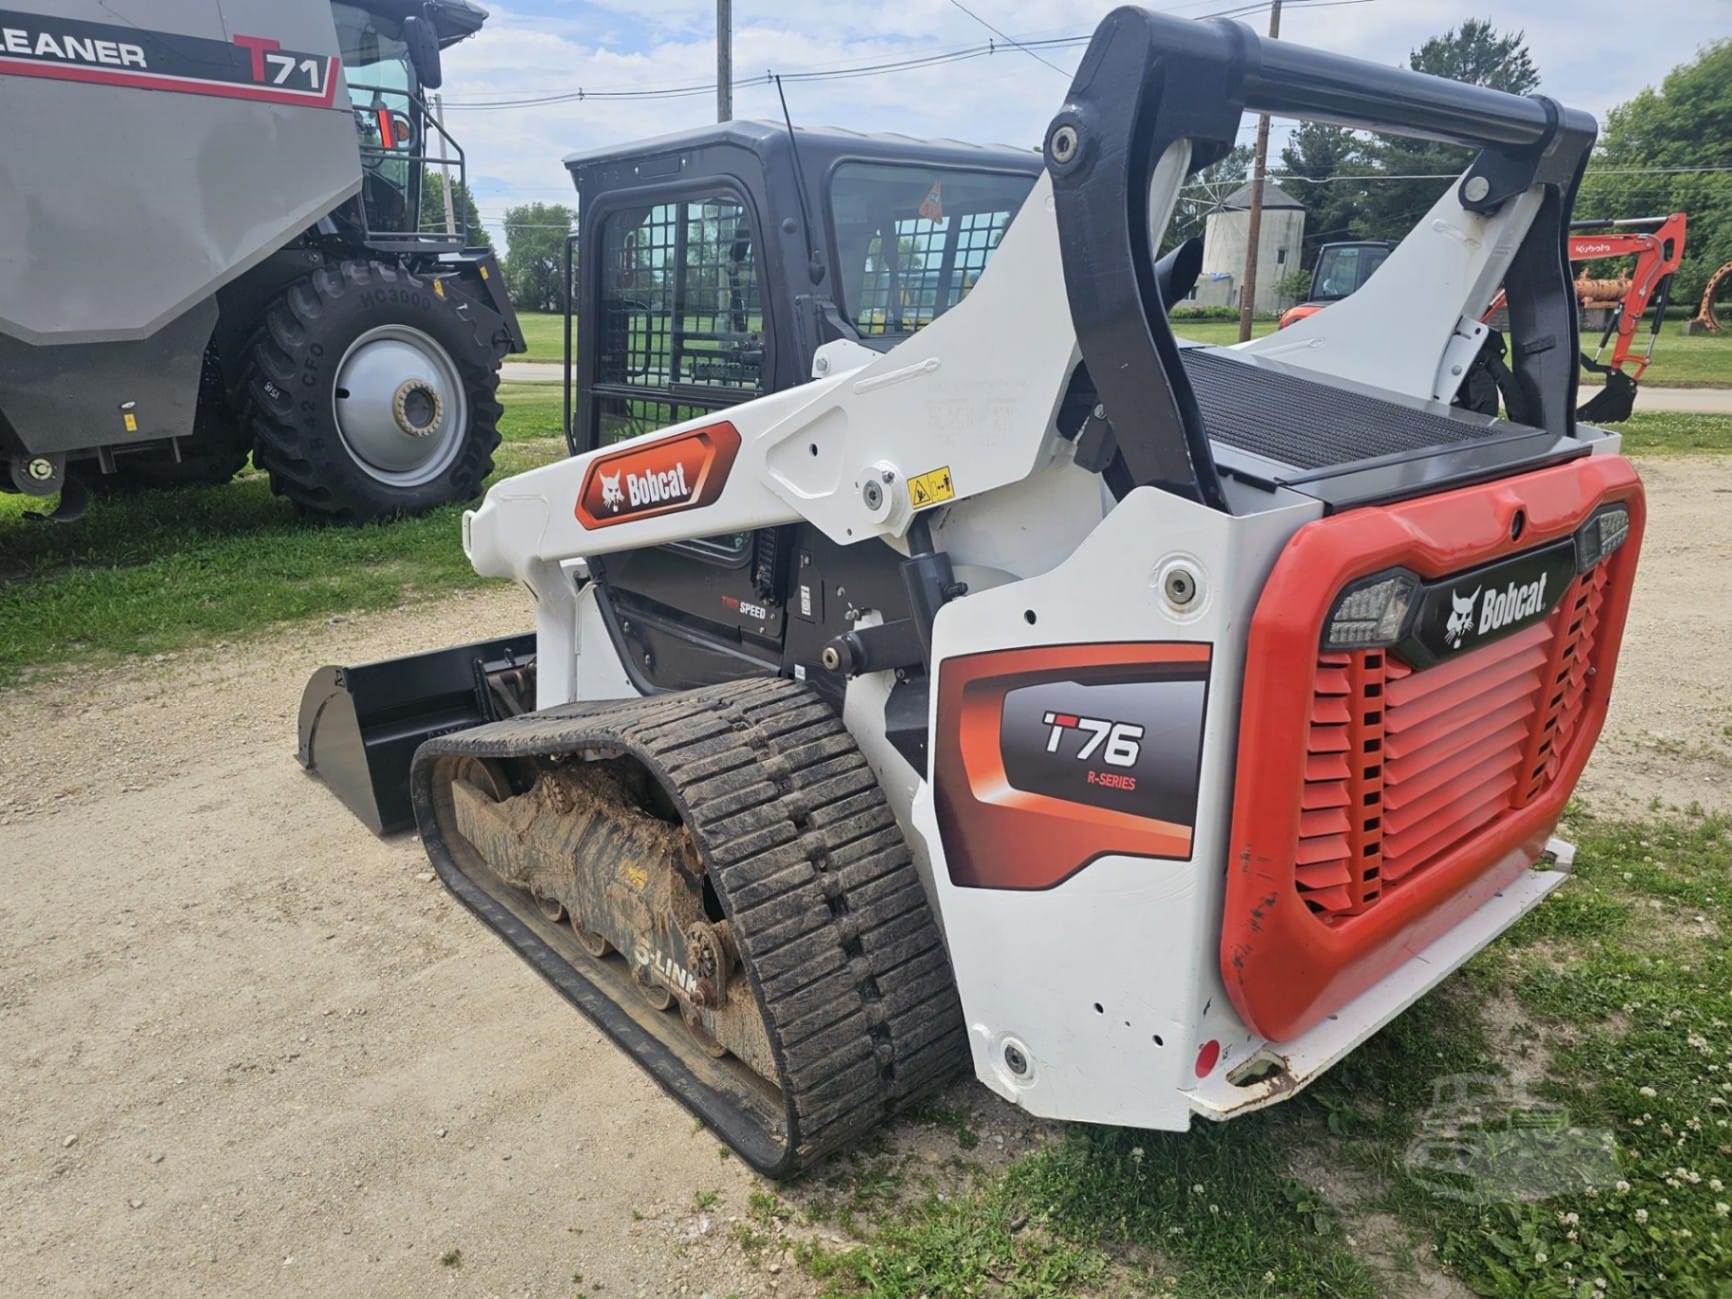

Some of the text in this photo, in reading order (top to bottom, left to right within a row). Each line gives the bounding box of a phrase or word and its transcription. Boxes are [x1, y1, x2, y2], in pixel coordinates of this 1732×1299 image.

[0, 27, 147, 68] EANER
[233, 33, 319, 89] T71
[1575, 244, 1611, 253] Kubota
[626, 462, 688, 507] Bobcat
[739, 601, 766, 620] SPEED
[1478, 571, 1547, 635] Bobcat
[1042, 711, 1145, 768] T76
[1087, 770, 1137, 791] R-SERIES
